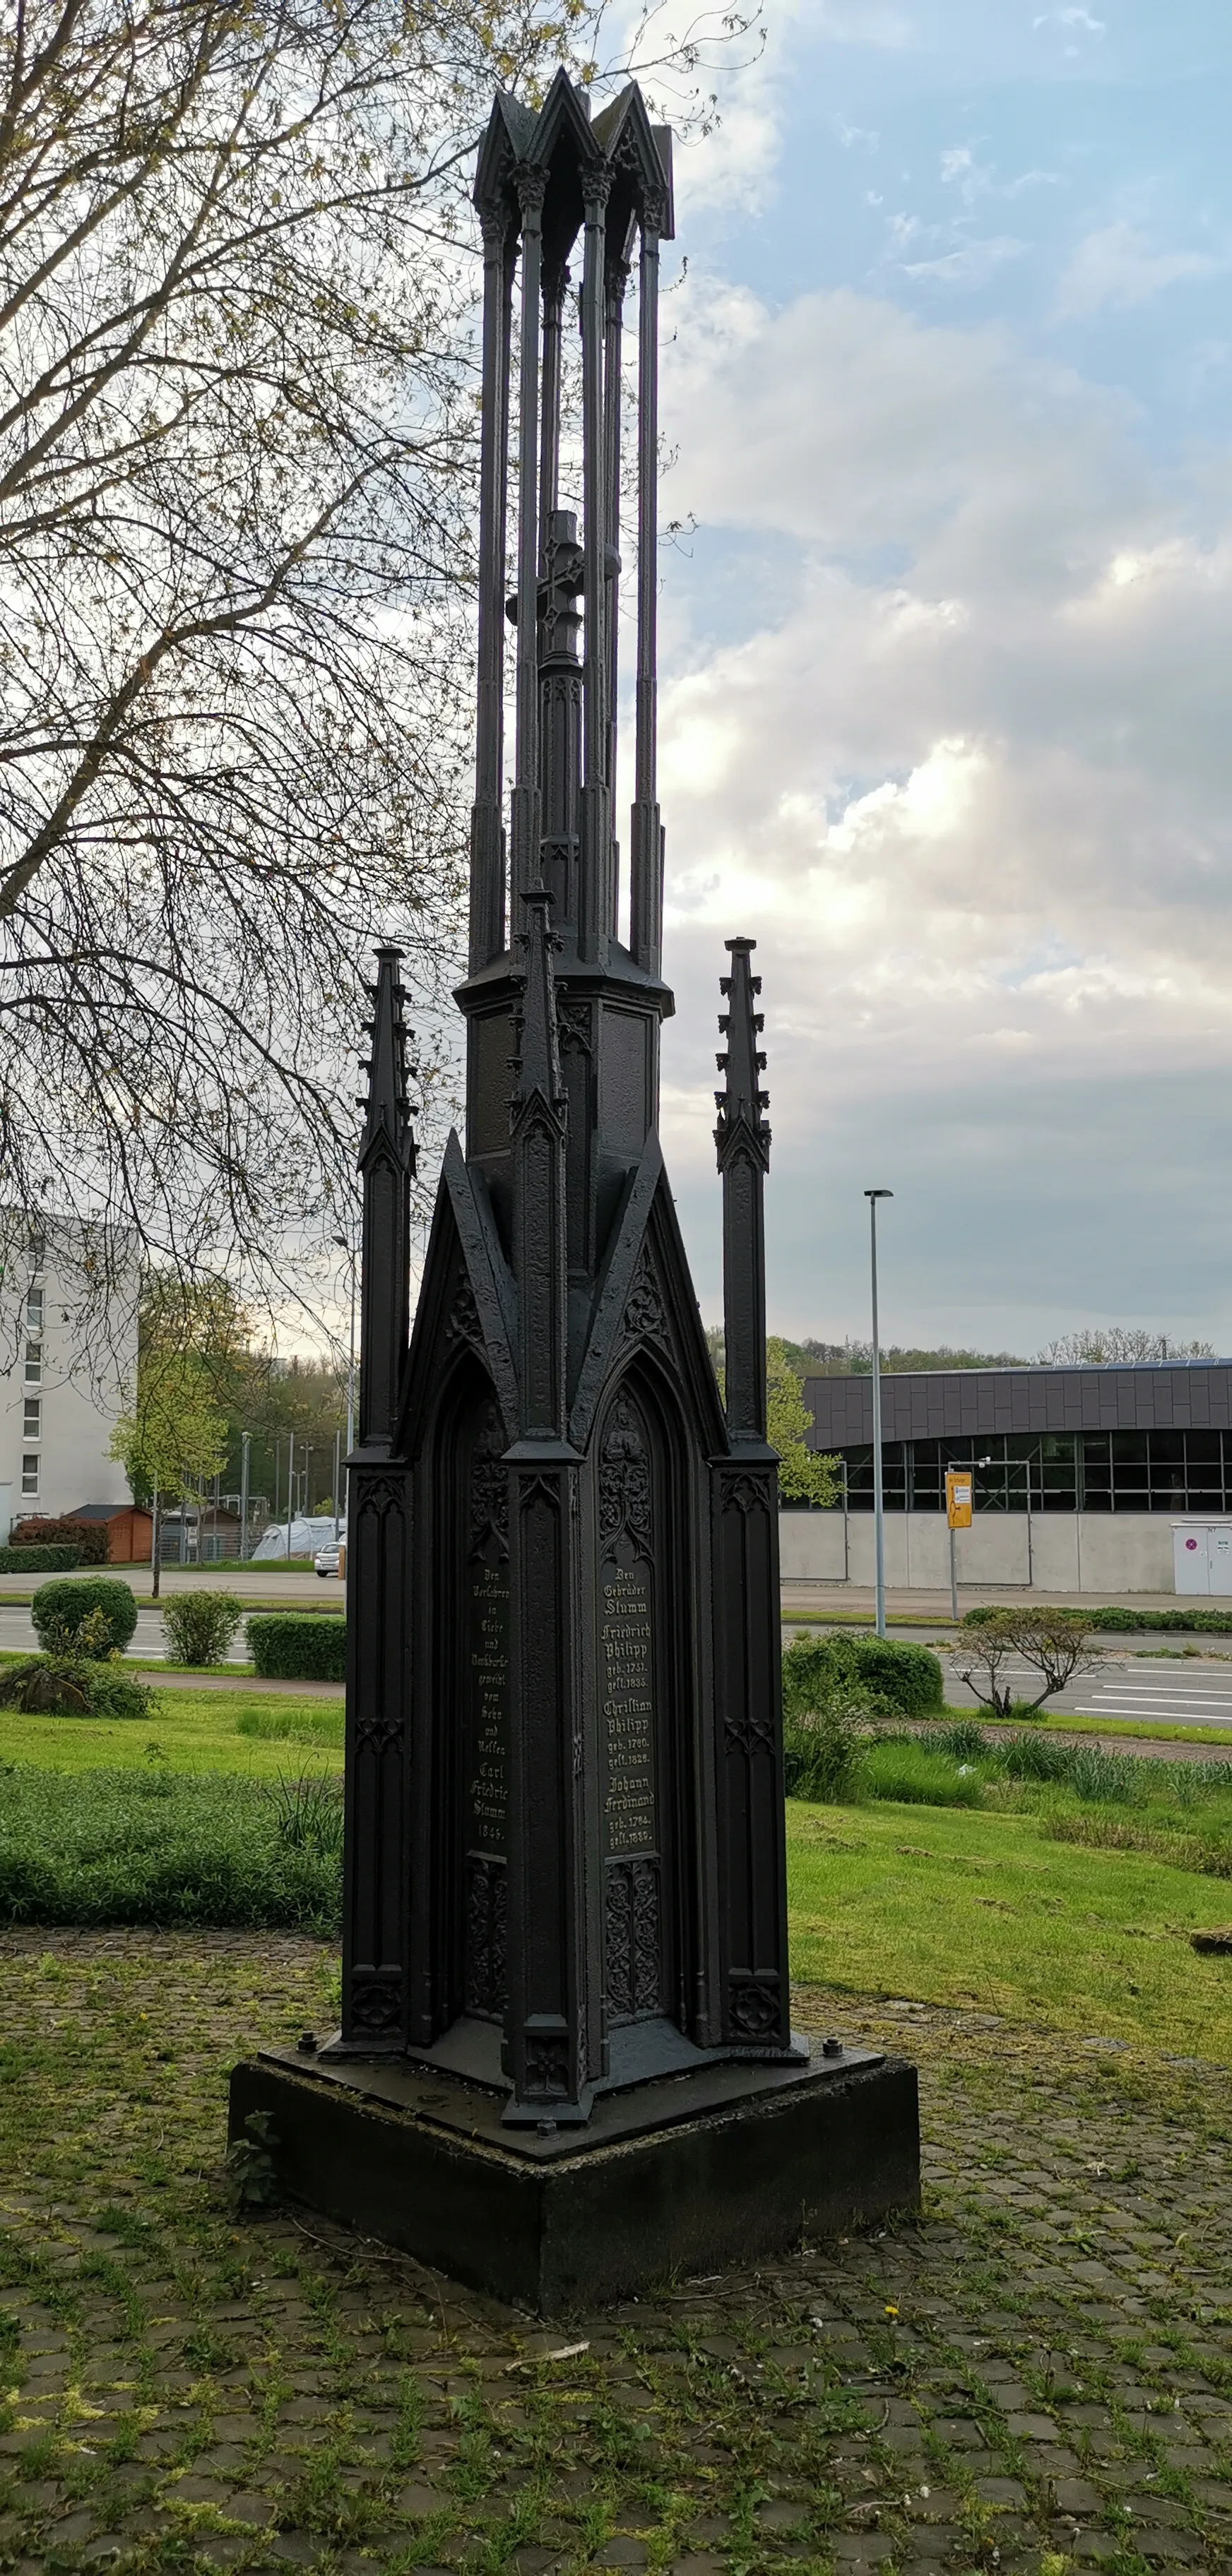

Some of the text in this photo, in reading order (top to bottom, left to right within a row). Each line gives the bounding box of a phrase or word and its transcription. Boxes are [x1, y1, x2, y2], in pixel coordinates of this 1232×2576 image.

[483, 1569, 499, 1581] Den
[615, 1568, 634, 1580] Den
[604, 1585, 646, 1598] Gebrüder
[488, 1602, 497, 1615] in
[604, 1599, 646, 1616] Stumm
[481, 1619, 504, 1633] Liebe
[601, 1622, 651, 1640] Friedrich
[485, 1638, 499, 1650] und
[604, 1642, 647, 1661] Philipp
[607, 1662, 648, 1678] geb. 1751.
[485, 1724, 498, 1737] und
[607, 1718, 648, 1736] Philipp
[608, 1739, 626, 1755] geb.
[479, 1761, 504, 1779] Carl
[469, 1779, 509, 1801] Friedric
[608, 1775, 648, 1794] Johann
[473, 1799, 507, 1820] Stumm
[604, 1791, 655, 1813] Ferdinand
[610, 1816, 627, 1834] geb.
